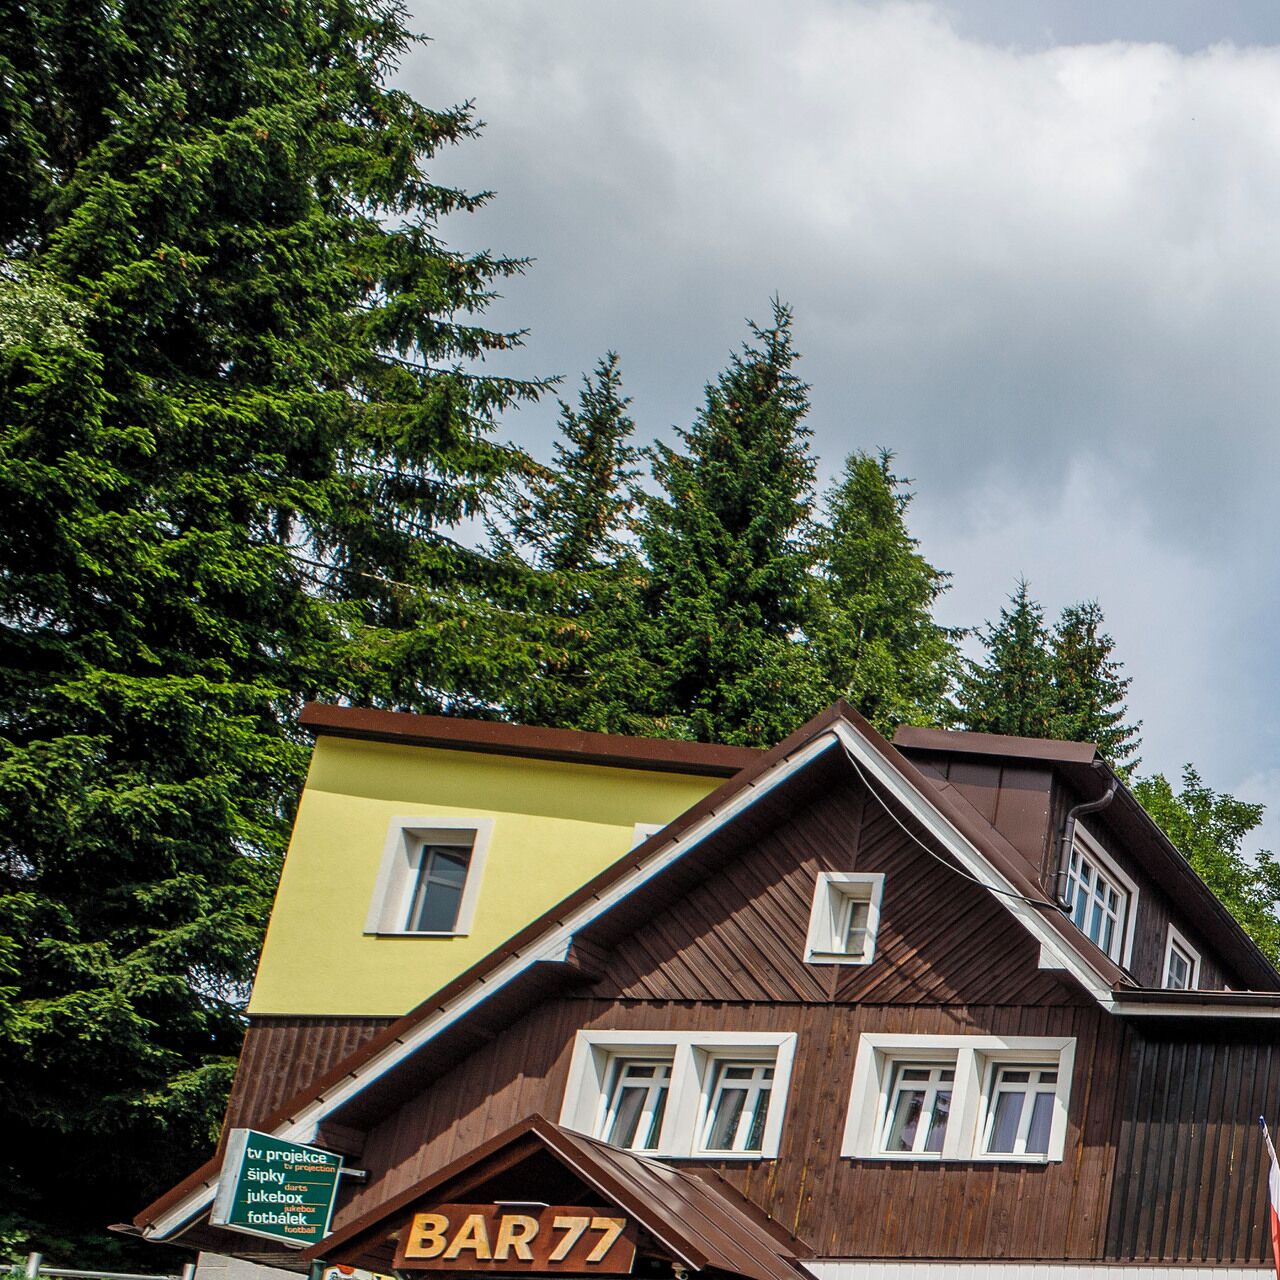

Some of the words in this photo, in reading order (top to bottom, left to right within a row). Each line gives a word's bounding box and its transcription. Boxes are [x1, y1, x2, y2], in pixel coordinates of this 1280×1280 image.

[247, 1147, 262, 1159] tv
[266, 1149, 327, 1163] projekce
[295, 1164, 335, 1173] projection
[247, 1167, 285, 1185] šipky
[284, 1184, 308, 1192] darts
[247, 1189, 304, 1204] jukebox
[284, 1205, 315, 1213] jukebox
[247, 1211, 308, 1225] fotbálek
[284, 1226, 316, 1234] football
[404, 1213, 540, 1261] BAR
[547, 1215, 627, 1263] 77
